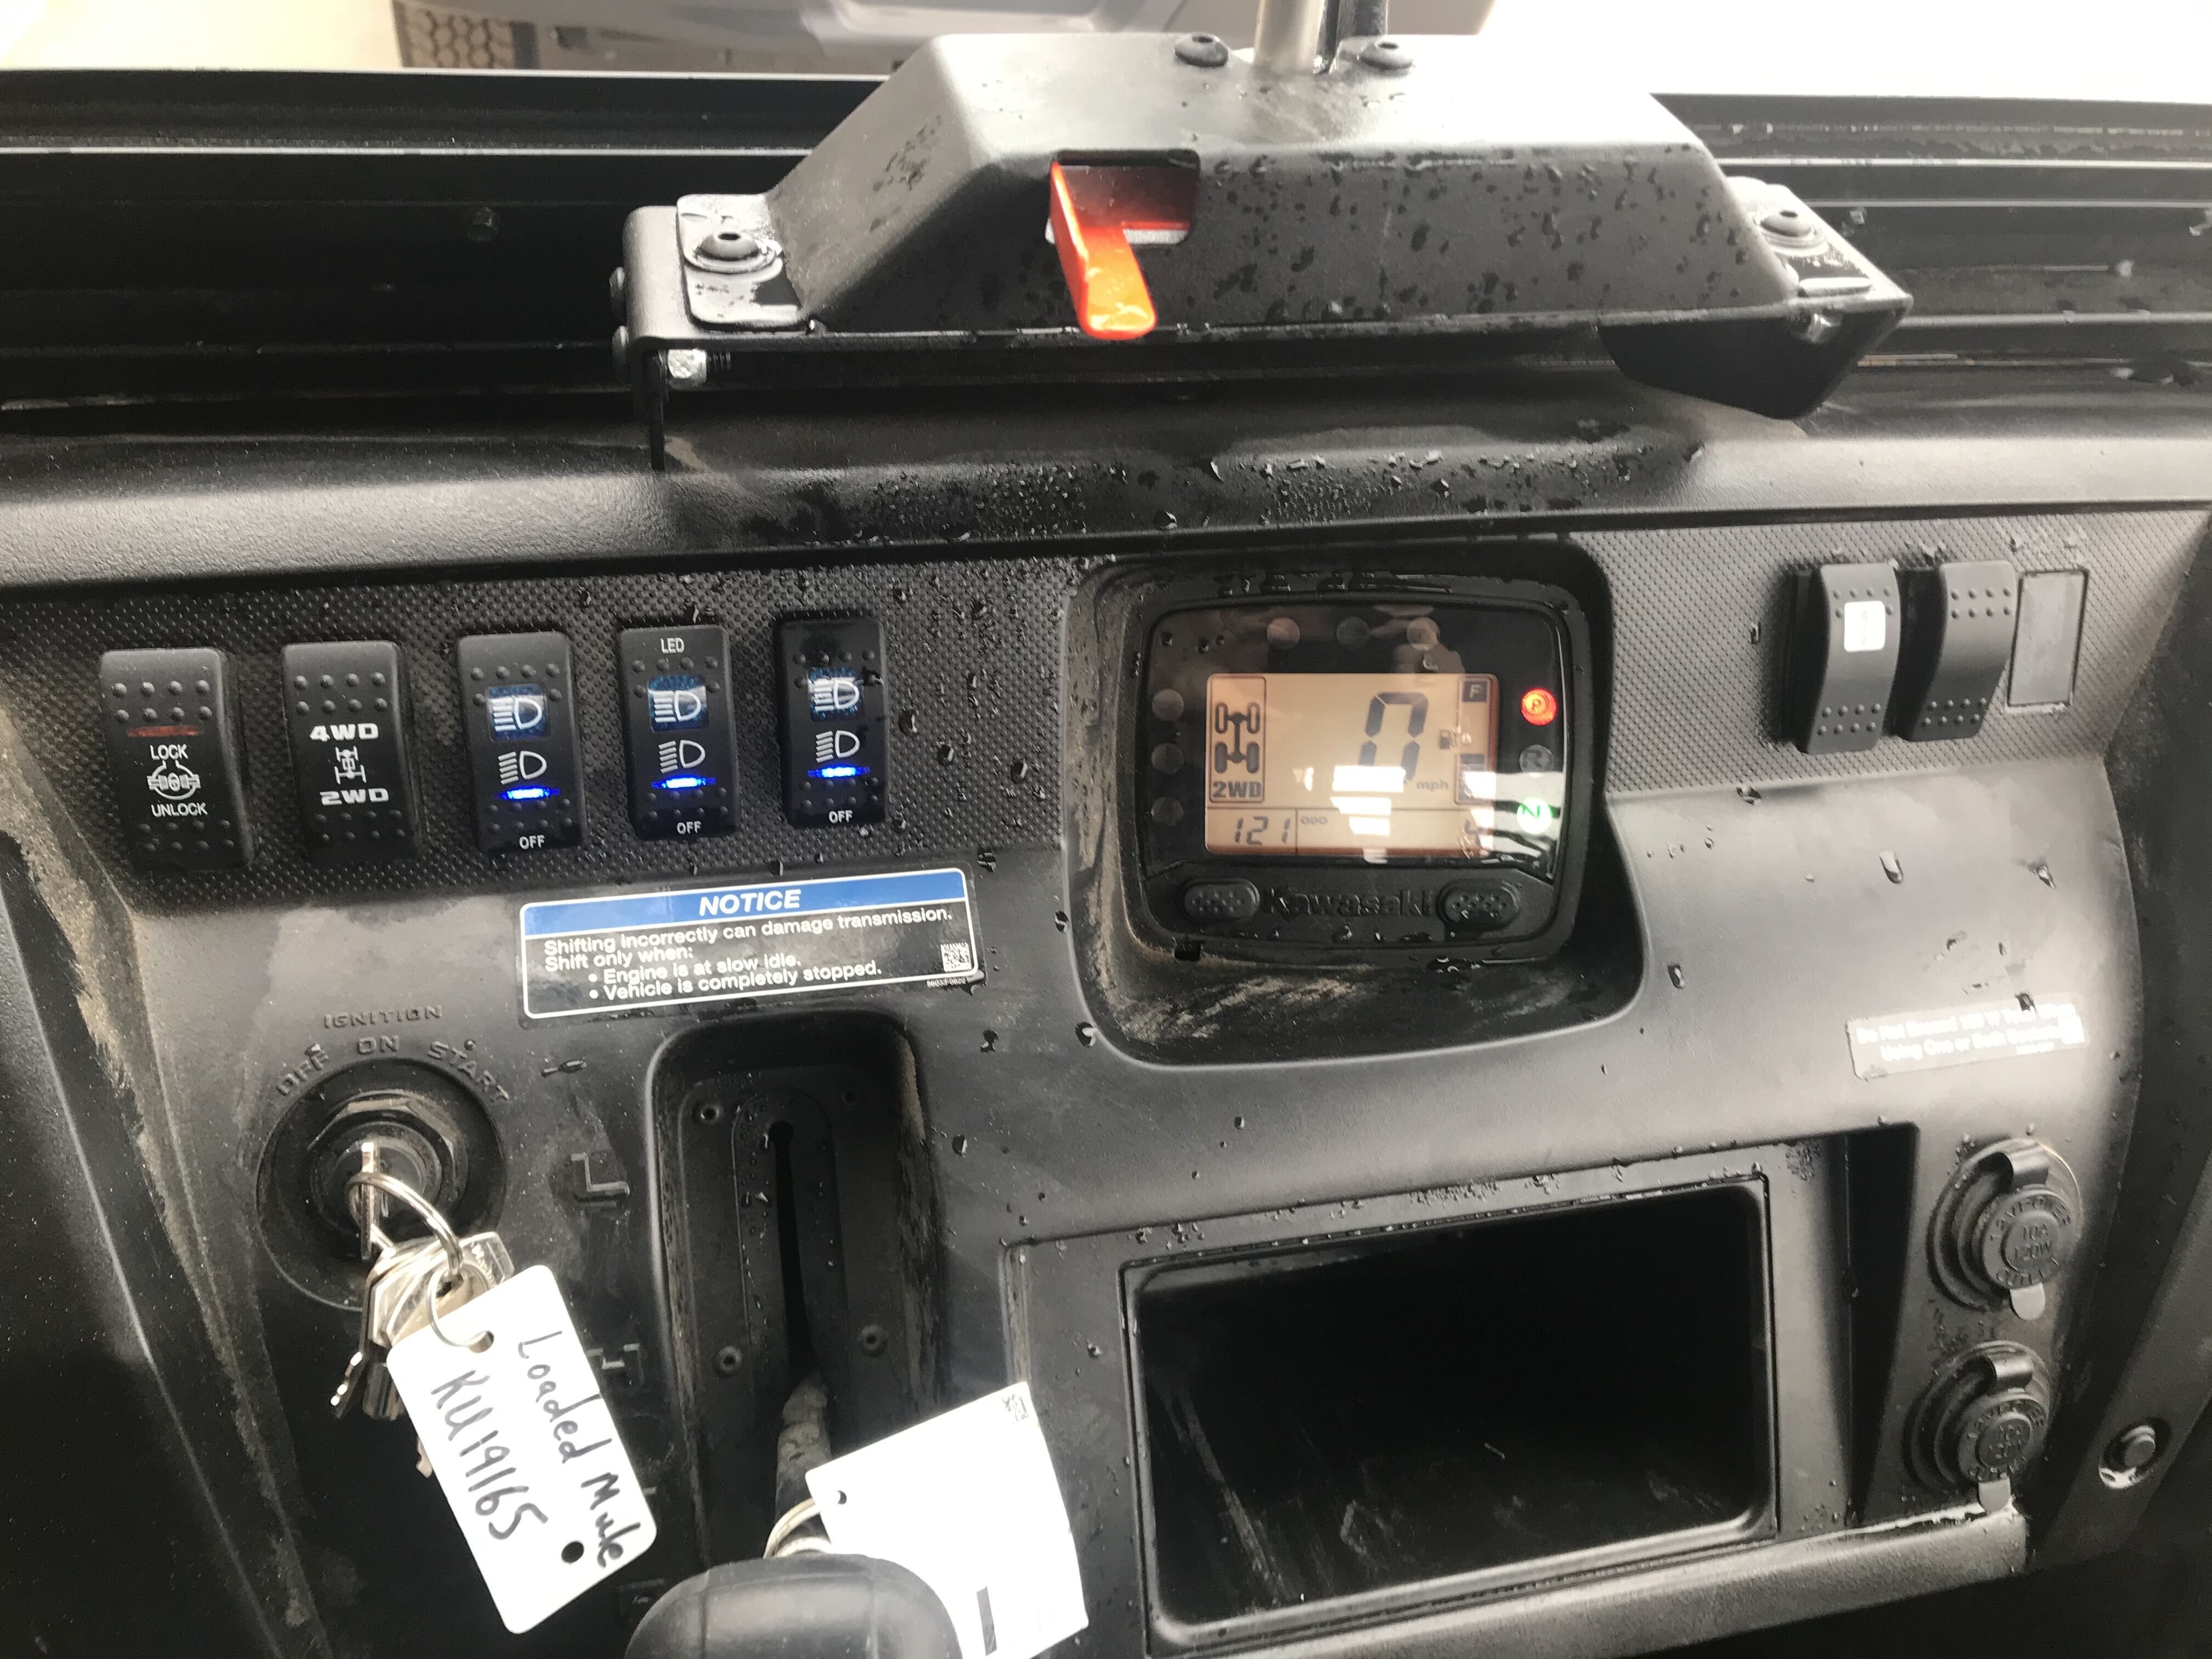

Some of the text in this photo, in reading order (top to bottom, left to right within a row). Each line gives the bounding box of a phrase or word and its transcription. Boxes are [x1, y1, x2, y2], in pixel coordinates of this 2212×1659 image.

[660, 638, 685, 654] LED
[309, 723, 379, 741] 4WD
[150, 744, 189, 760] LOCK
[1212, 780, 1262, 798] 2WD
[1417, 779, 1449, 792] mph
[319, 788, 389, 805] 2WD
[151, 802, 208, 817] UNLOCK
[828, 809, 853, 823] OFF
[676, 820, 702, 835] OFF
[1301, 816, 1328, 825] ODO
[519, 834, 545, 850] OFF
[699, 889, 802, 917] NOTICE
[1264, 887, 1433, 918] Kawasaki
[544, 907, 952, 956] Shifting incorrectly can damage transmission.
[545, 946, 693, 972] Shift only when:
[604, 952, 801, 986] Engine is at slow idle.
[603, 960, 882, 1001] Vehicle is completely stopped.
[324, 1005, 443, 1030] IGNITION
[357, 1035, 400, 1055] ON
[427, 1041, 509, 1101] START
[518, 1330, 641, 1568] Loaded Mule
